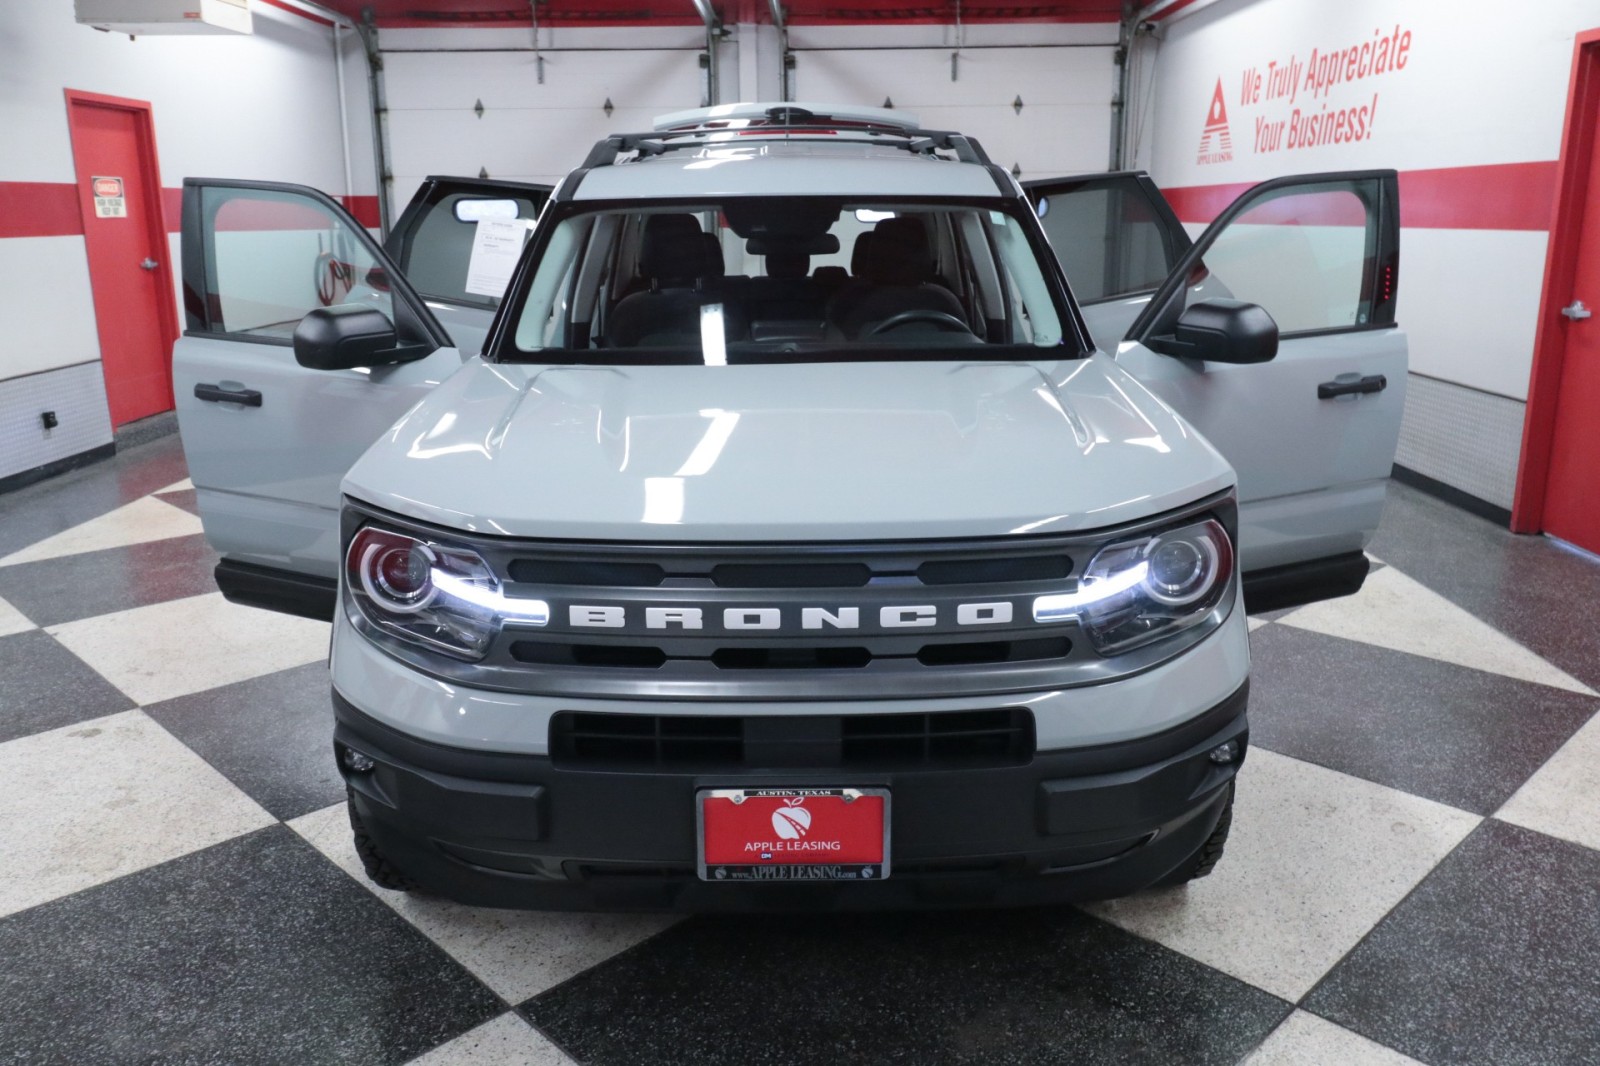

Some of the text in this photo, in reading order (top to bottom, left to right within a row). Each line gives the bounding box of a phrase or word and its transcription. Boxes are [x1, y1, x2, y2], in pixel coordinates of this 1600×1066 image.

[1241, 24, 1412, 106] We Truly Appreciate
[1254, 93, 1378, 153] Your Business!
[569, 601, 1013, 630] BRONCO
[744, 841, 841, 851] APPLE LEASING
